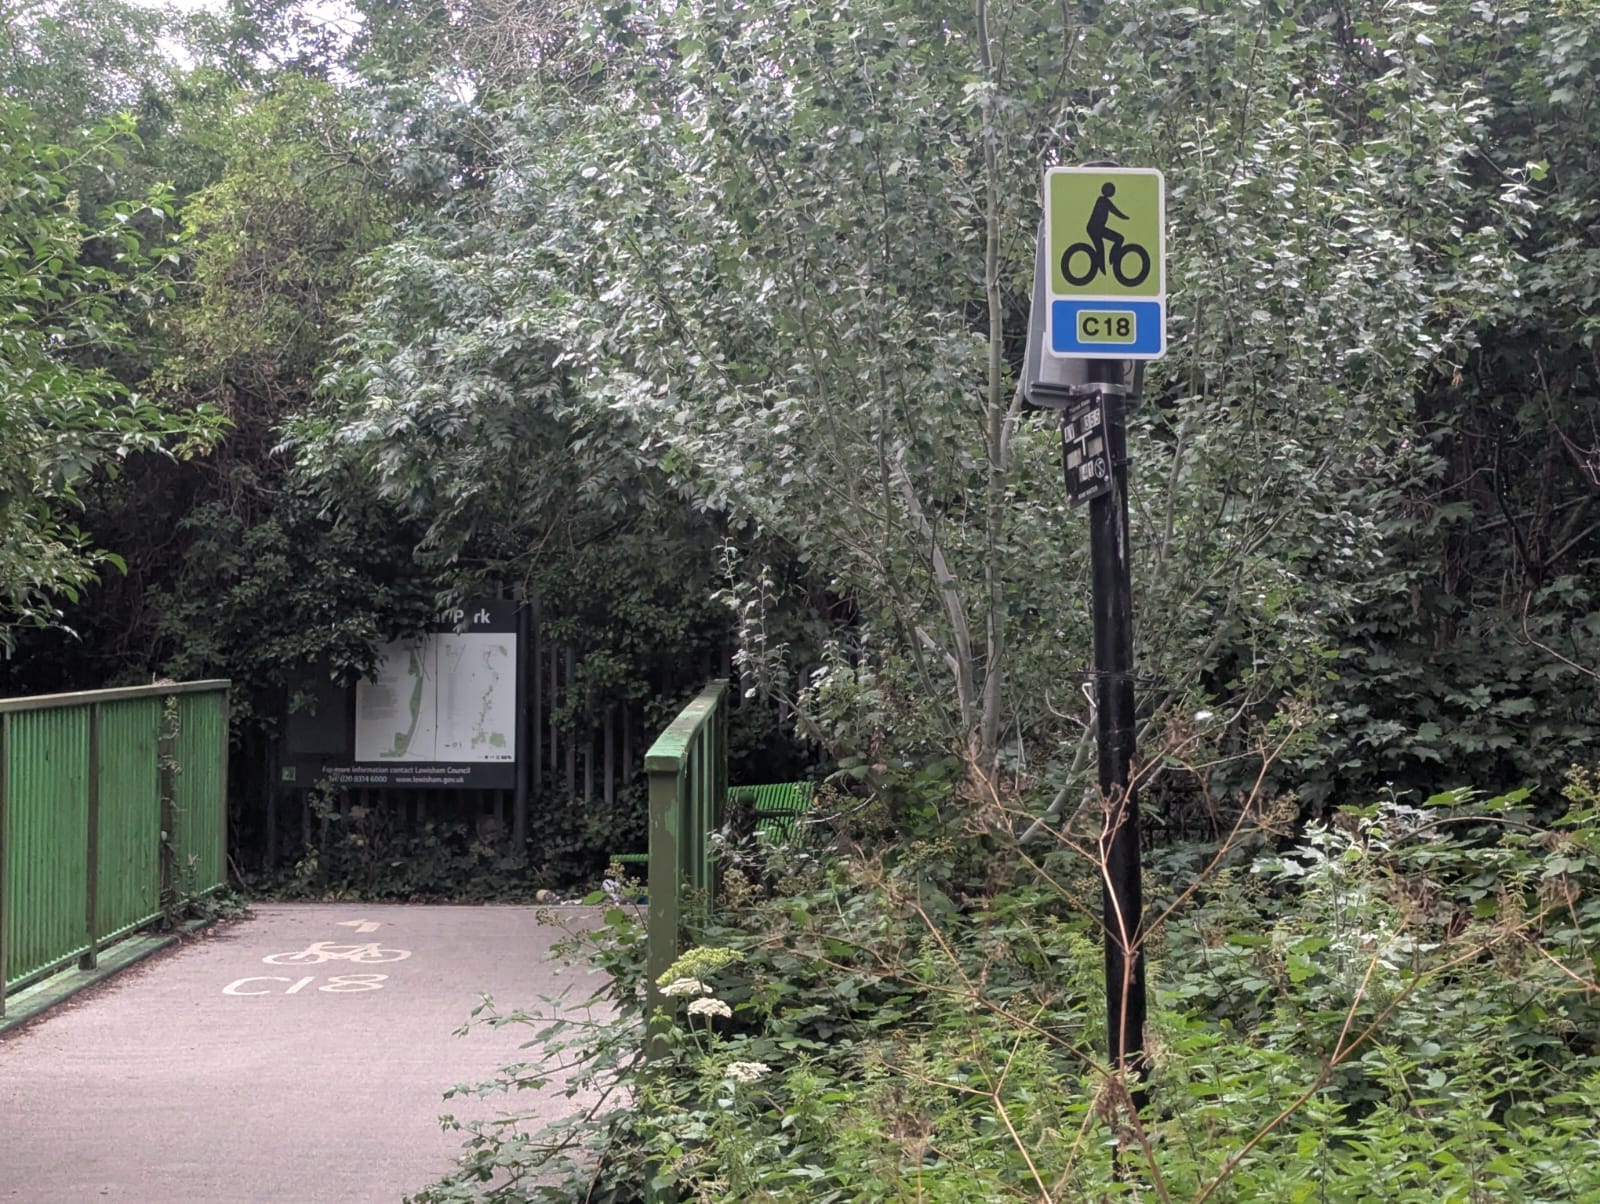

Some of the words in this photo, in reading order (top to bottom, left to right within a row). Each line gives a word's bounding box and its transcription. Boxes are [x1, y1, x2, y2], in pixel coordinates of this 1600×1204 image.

[1082, 317, 1130, 337] C18
[453, 608, 492, 624] Prk
[352, 765, 389, 774] information
[390, 766, 414, 774] contact
[415, 765, 446, 774] Lewisham
[447, 765, 472, 774] Council
[222, 973, 390, 996] C18
